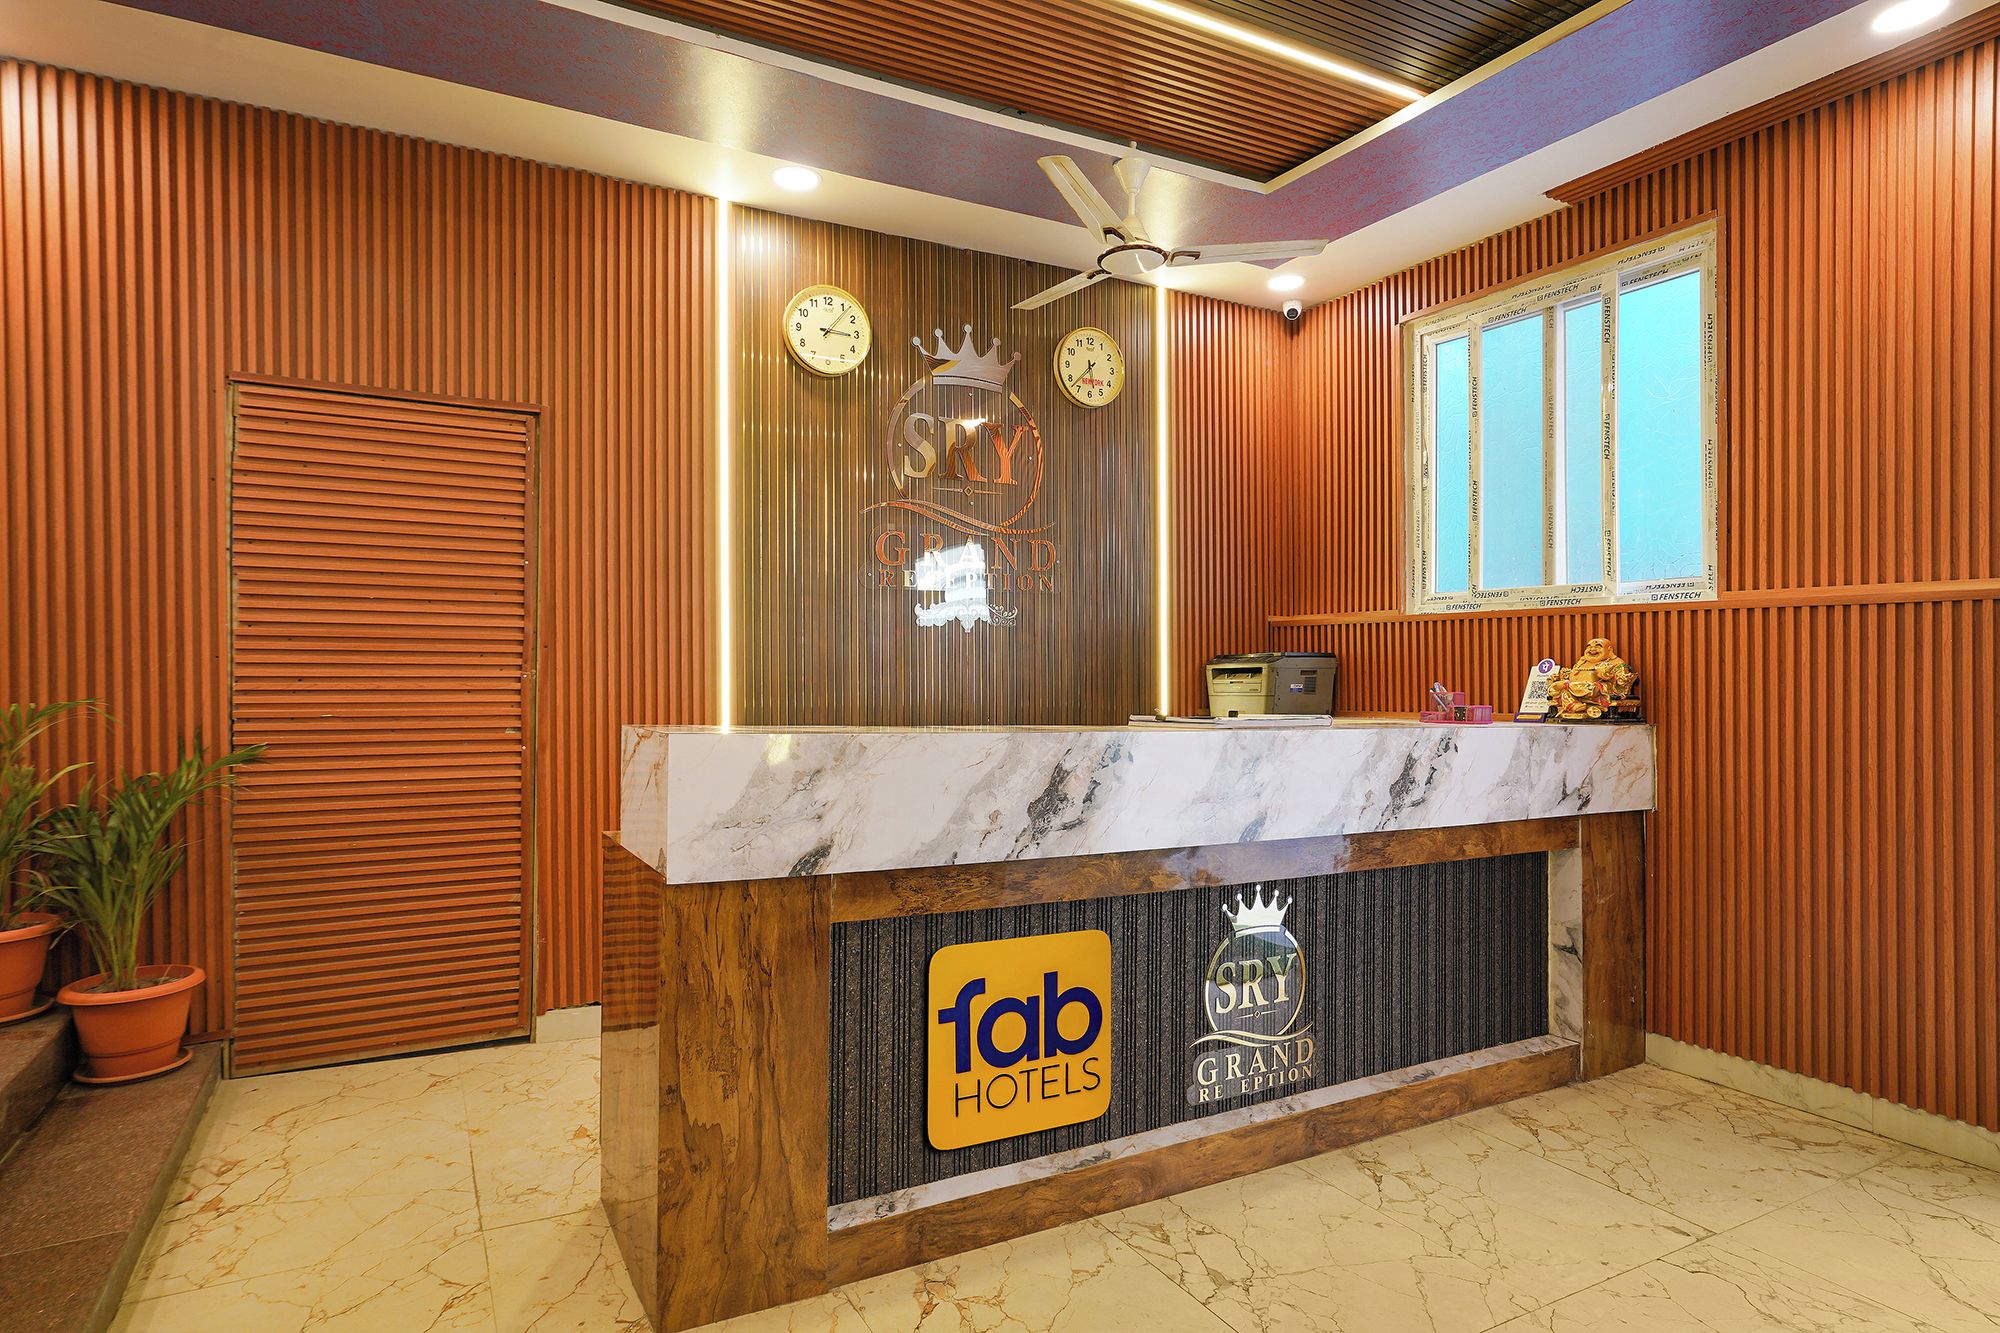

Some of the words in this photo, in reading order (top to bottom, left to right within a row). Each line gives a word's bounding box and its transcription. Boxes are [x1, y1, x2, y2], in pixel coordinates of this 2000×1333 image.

[1544, 284, 1580, 300] FENSTECH
[810, 299, 818, 308] 11
[823, 296, 833, 306] 12
[840, 303, 844, 311] 1
[798, 308, 808, 317] 10
[1494, 306, 1528, 322] FENSTECH
[850, 315, 856, 324] 2
[796, 322, 802, 331] 9
[854, 330, 859, 339] 3
[800, 338, 805, 347] 8
[1076, 339, 1082, 347] 11
[1086, 337, 1094, 345] 12
[850, 345, 856, 354] 4
[1067, 348, 1075, 356] 10
[1068, 374, 1073, 382] 8
[904, 412, 1028, 485] SRY
[875, 530, 1056, 572] GRAND
[878, 568, 1054, 592] REEPTION
[1659, 592, 1702, 601] FENSTECH
[1215, 952, 1297, 1014] SRY
[938, 971, 1102, 1074] fab
[1197, 1038, 1314, 1086] GRAND
[956, 1057, 1100, 1117] HOTELS
